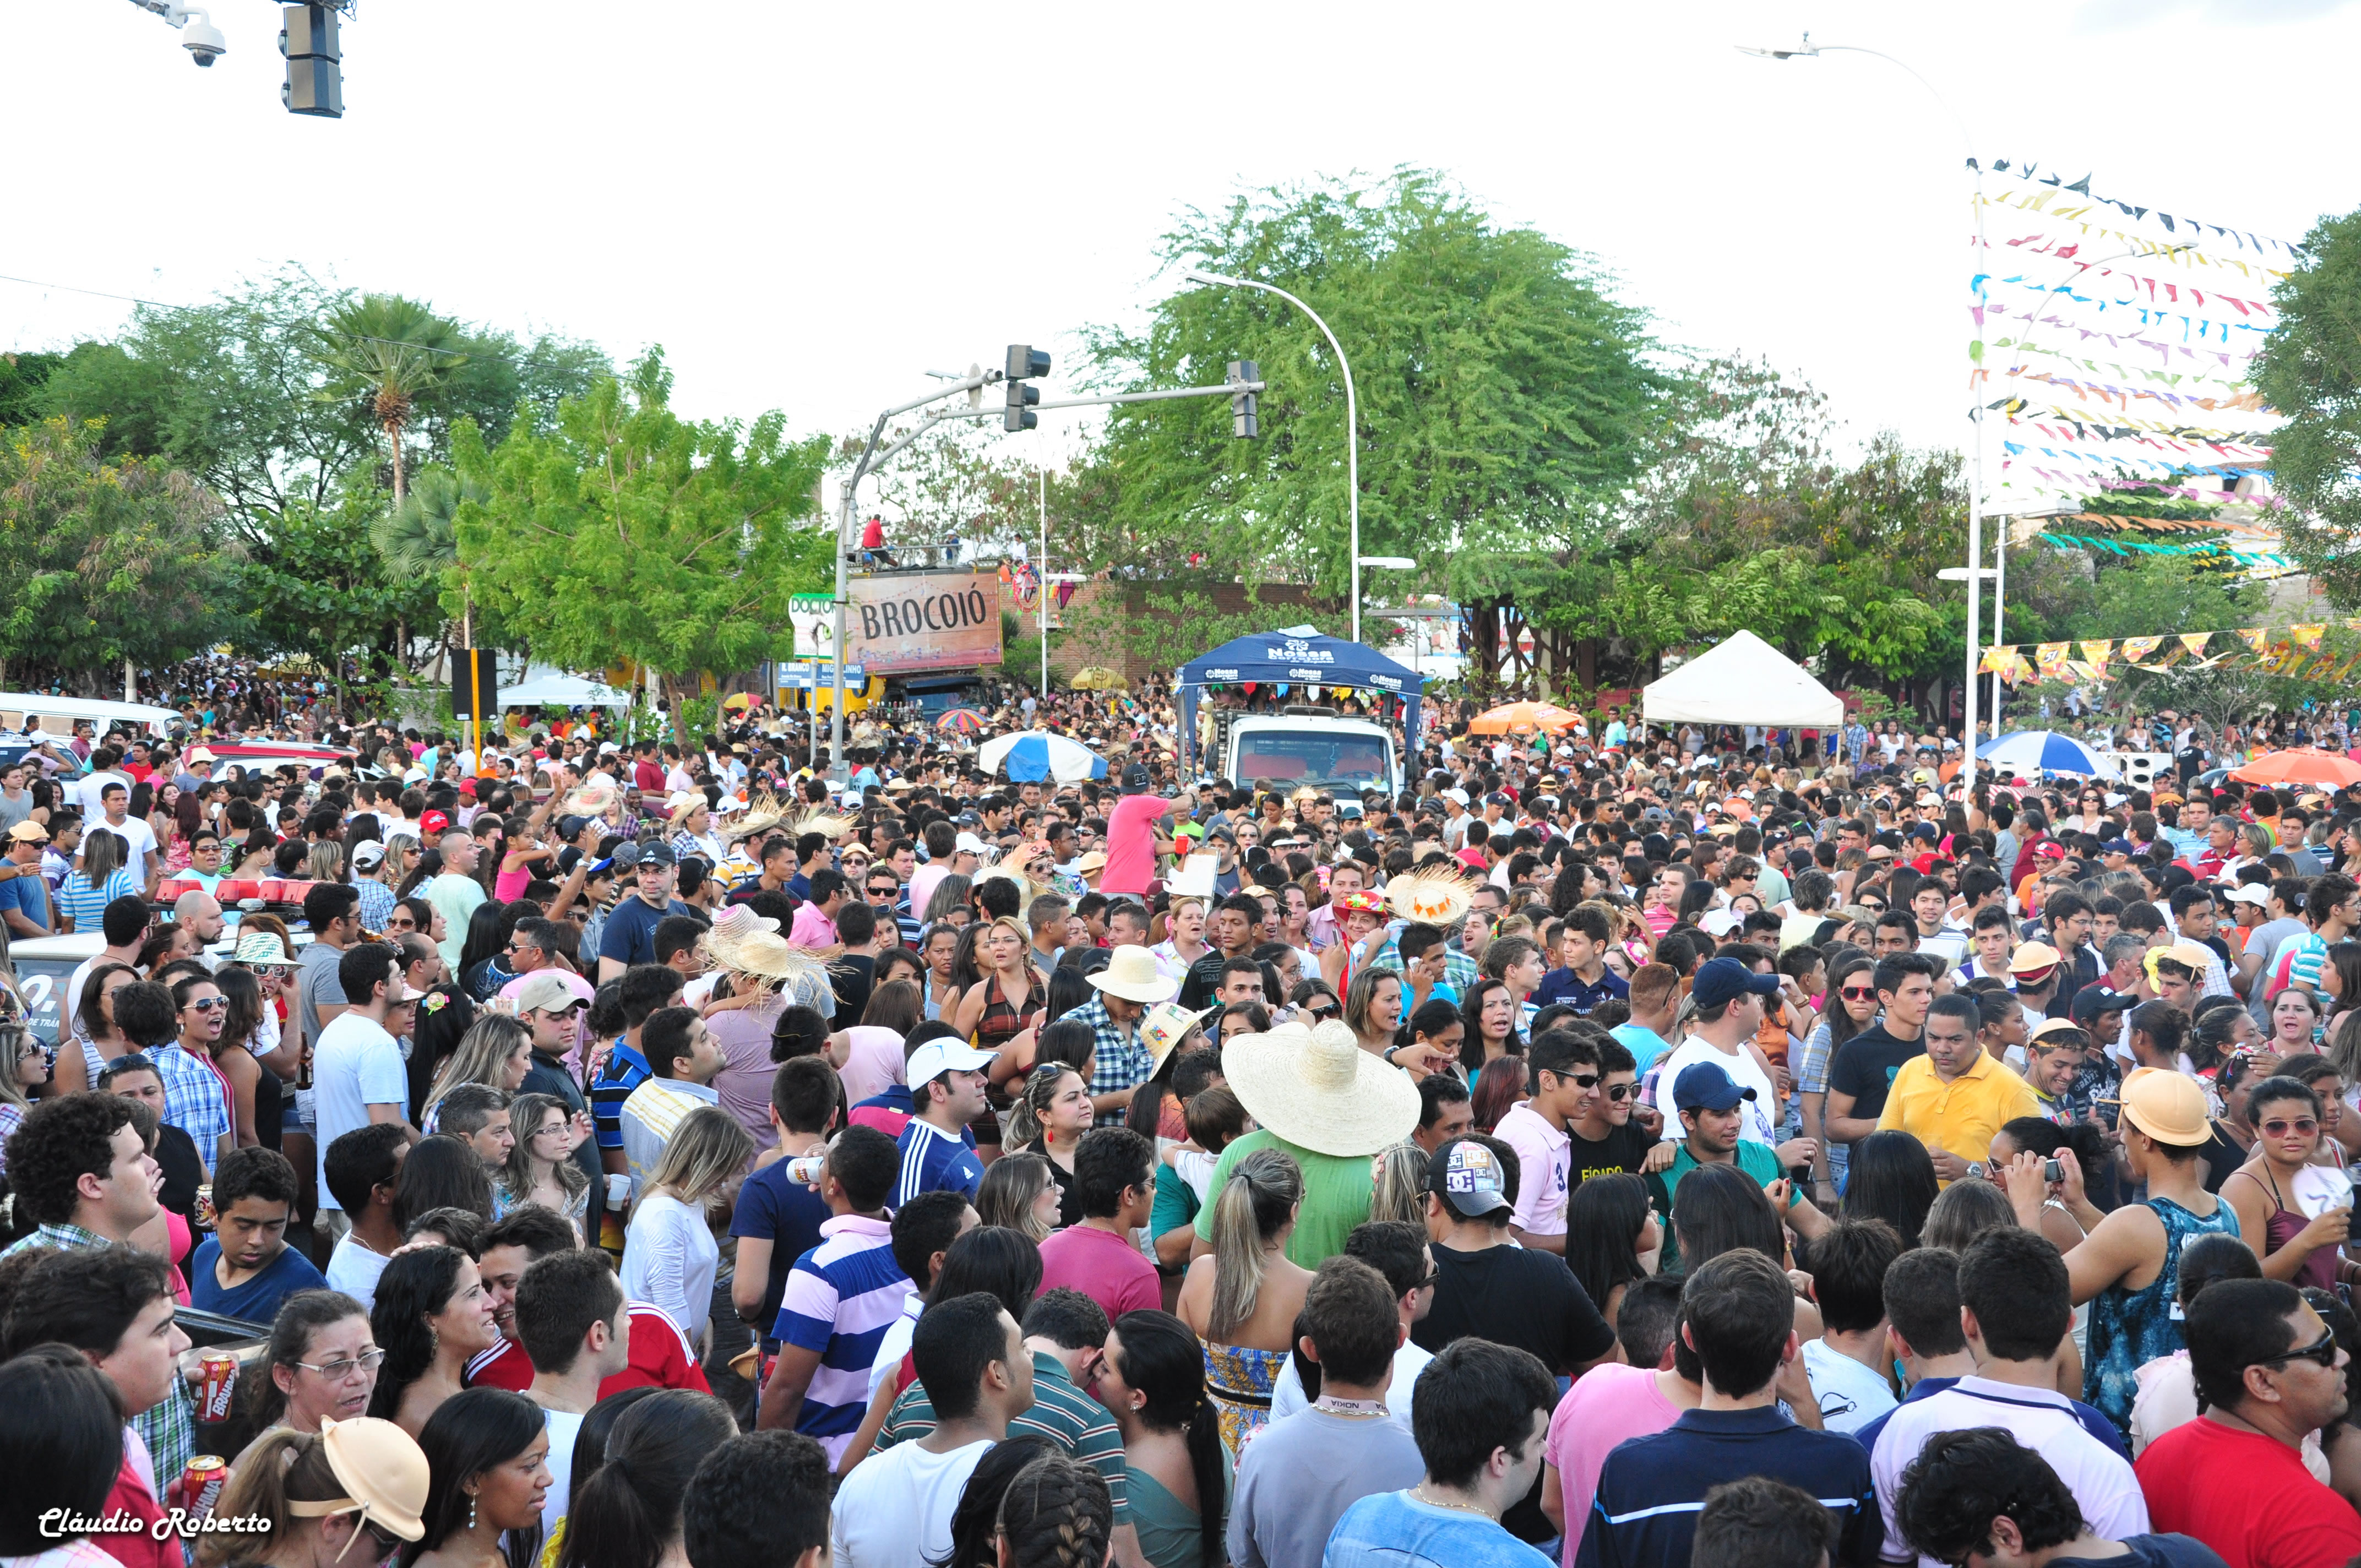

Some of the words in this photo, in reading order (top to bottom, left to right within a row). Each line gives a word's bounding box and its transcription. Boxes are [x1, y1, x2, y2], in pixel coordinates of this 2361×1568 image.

[861, 582, 986, 640] BROCOIÓ
[1267, 647, 1332, 657] Nossa
[2043, 650, 2058, 662] 51
[28, 1017, 39, 1026] DE
[1555, 1162, 1566, 1192] 3
[212, 1369, 236, 1417] BRAHMA
[1331, 1399, 1359, 1408] NOKIA
